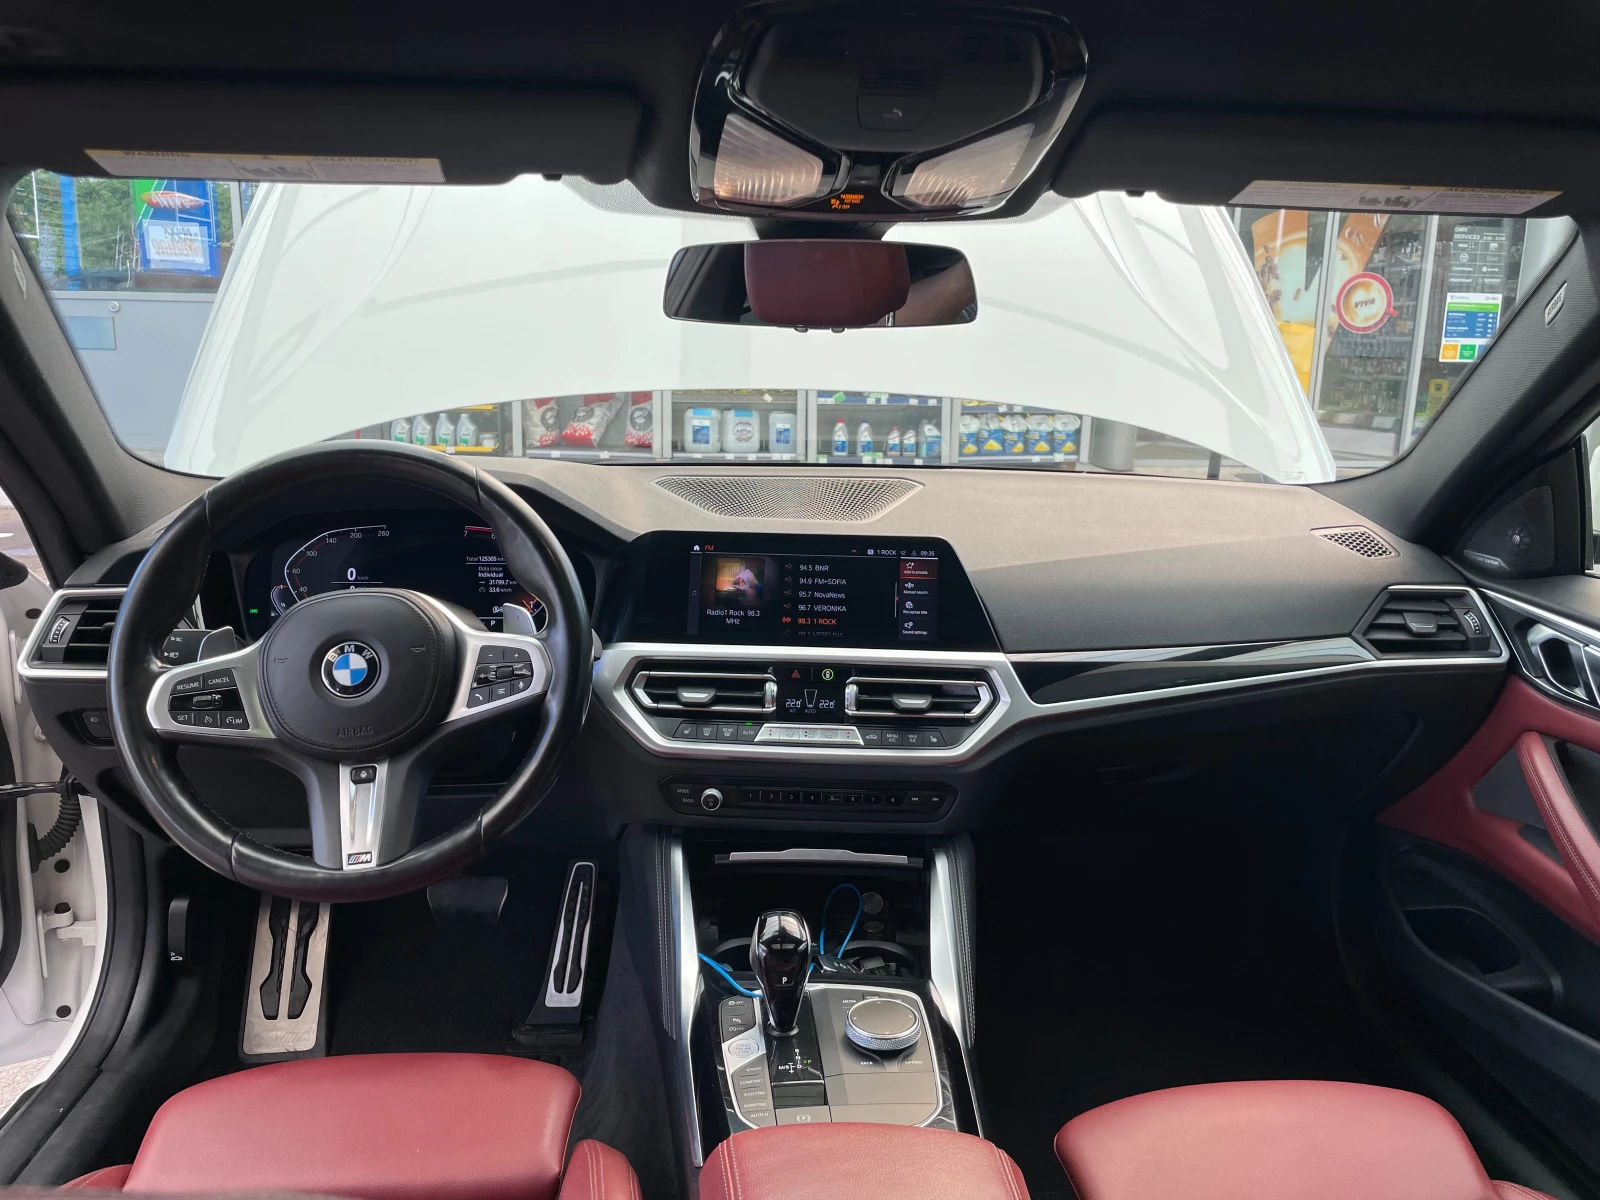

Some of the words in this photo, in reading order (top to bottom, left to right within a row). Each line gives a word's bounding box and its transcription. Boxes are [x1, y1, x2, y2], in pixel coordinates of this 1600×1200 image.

[123, 150, 191, 158] WARNING
[1354, 298, 1376, 309] VIVA
[347, 567, 357, 580] 0
[328, 644, 373, 662] BMW
[176, 681, 200, 690] RESUME
[208, 676, 230, 685] CANCEL
[336, 725, 374, 738] AIRBAG
[782, 976, 788, 985] P
